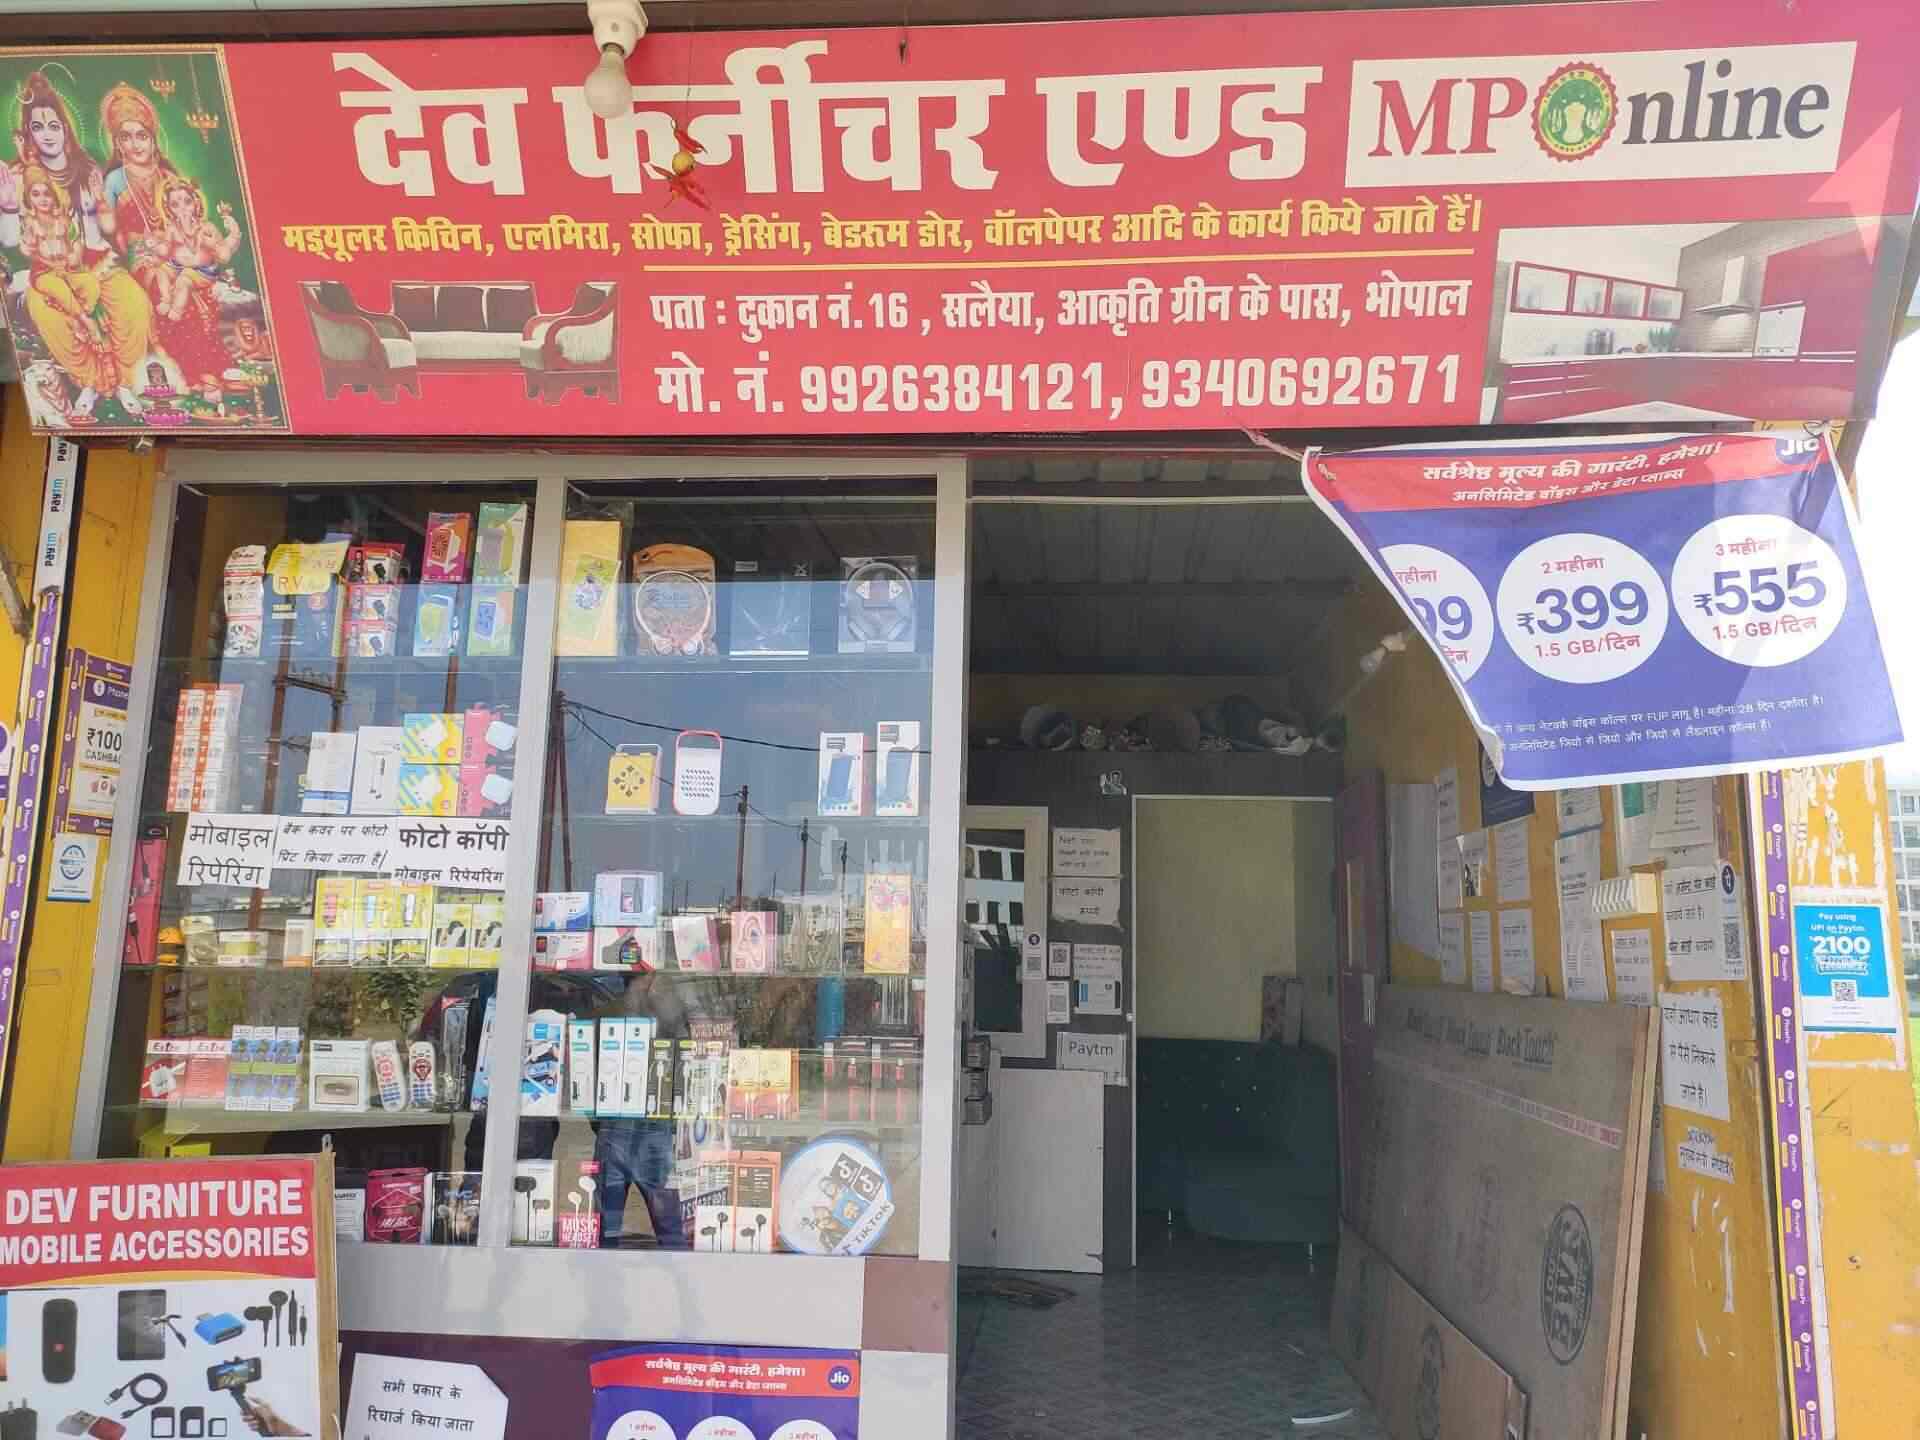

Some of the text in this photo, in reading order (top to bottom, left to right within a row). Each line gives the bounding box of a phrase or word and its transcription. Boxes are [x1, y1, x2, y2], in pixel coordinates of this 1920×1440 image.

[333, 52, 528, 196] देव
[1036, 66, 1323, 187] एण्ड
[502, 213, 621, 256] एलमिरा,
[629, 213, 713, 256] सोफा,
[720, 212, 812, 256] ड्रेसिंग,
[917, 210, 972, 253] डोर,
[984, 208, 1104, 245] वॉलपेपर
[1112, 204, 1185, 242] आदि
[1191, 202, 1222, 239] के
[1228, 199, 1293, 238] कार्य
[1300, 198, 1365, 236] किये
[1373, 195, 1439, 234] जाते
[649, 295, 706, 330] पता
[736, 295, 819, 344] दुकान
[941, 279, 1045, 336] सलैया,
[1057, 277, 1163, 337] आकृति
[1170, 276, 1233, 325] ग्रीन
[1239, 273, 1272, 321] के
[1279, 282, 1351, 327] पास,
[1366, 269, 1472, 319] भोपाल
[654, 350, 1460, 420] मो. नं. 9926384121, 9340692671
[1499, 463, 1547, 485] मूल्य
[1551, 459, 1582, 478] की
[1715, 537, 1777, 557] 3 महीना
[1542, 555, 1605, 574] 2 महीना
[1712, 624, 1739, 640] 1.5
[1535, 640, 1561, 658] 1.5
[399, 823, 511, 851] फोटो कॉपी
[5, 1178, 304, 1225] DEV FURNITURE
[0, 1225, 310, 1265] MOBILE ACCESSORIES
[829, 1371, 850, 1385] Jio
